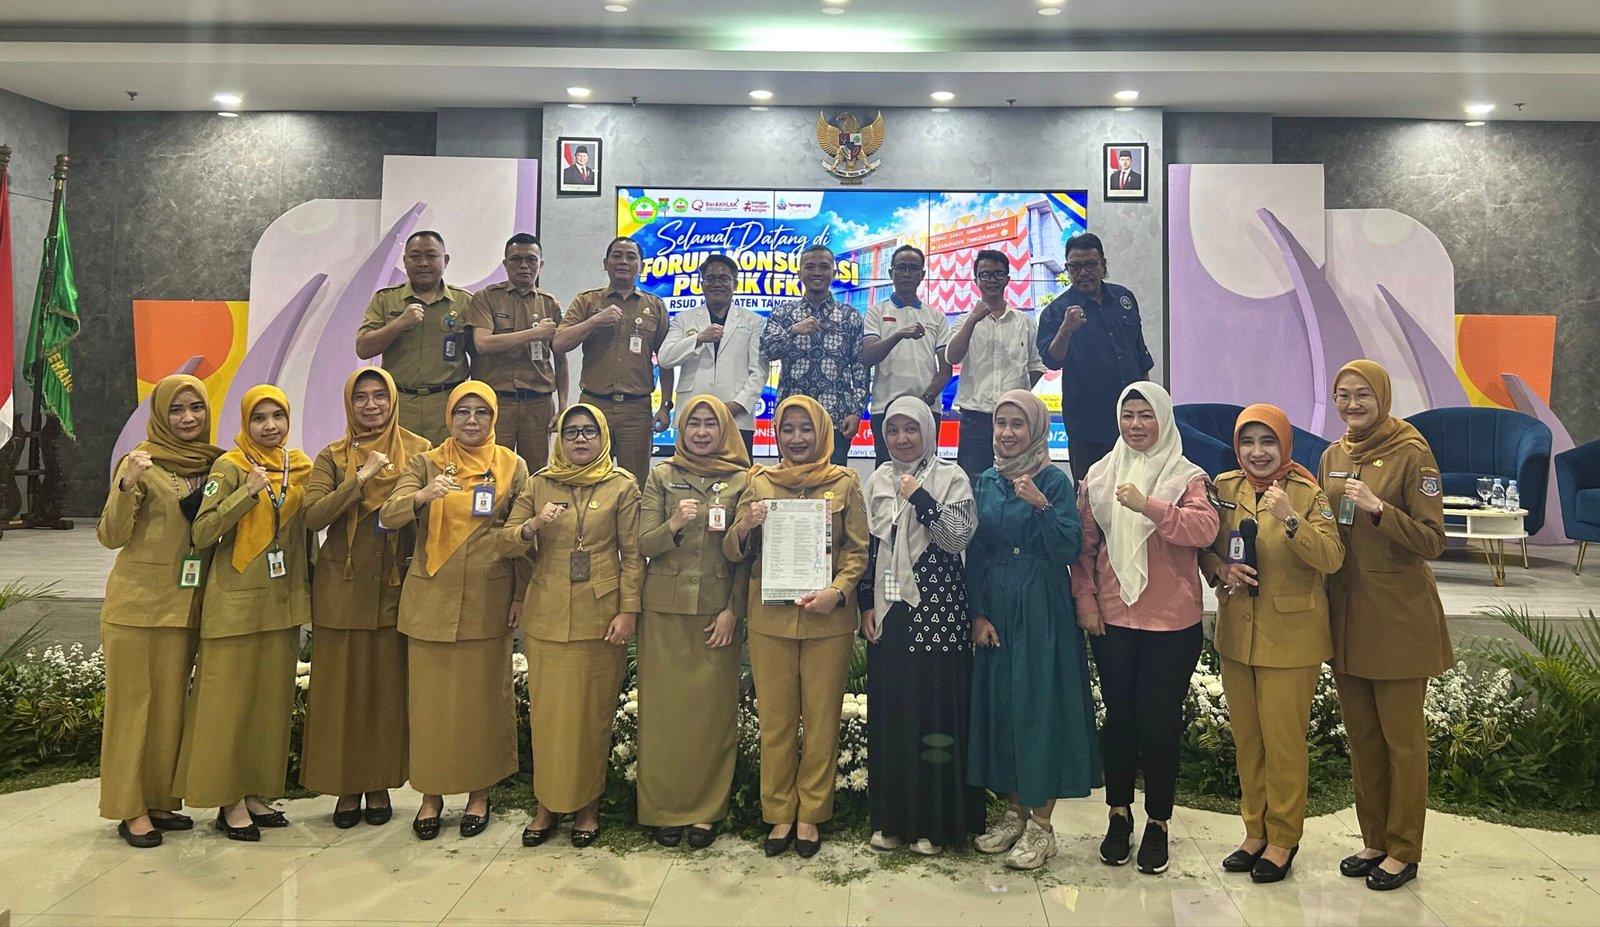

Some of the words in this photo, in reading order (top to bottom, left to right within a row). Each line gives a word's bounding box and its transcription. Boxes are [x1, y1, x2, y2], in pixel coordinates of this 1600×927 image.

[657, 220, 736, 255] Selamat
[735, 221, 808, 258] Datang
[812, 224, 830, 246] di
[673, 271, 761, 297] PUIK
[669, 299, 697, 309] RSUD
